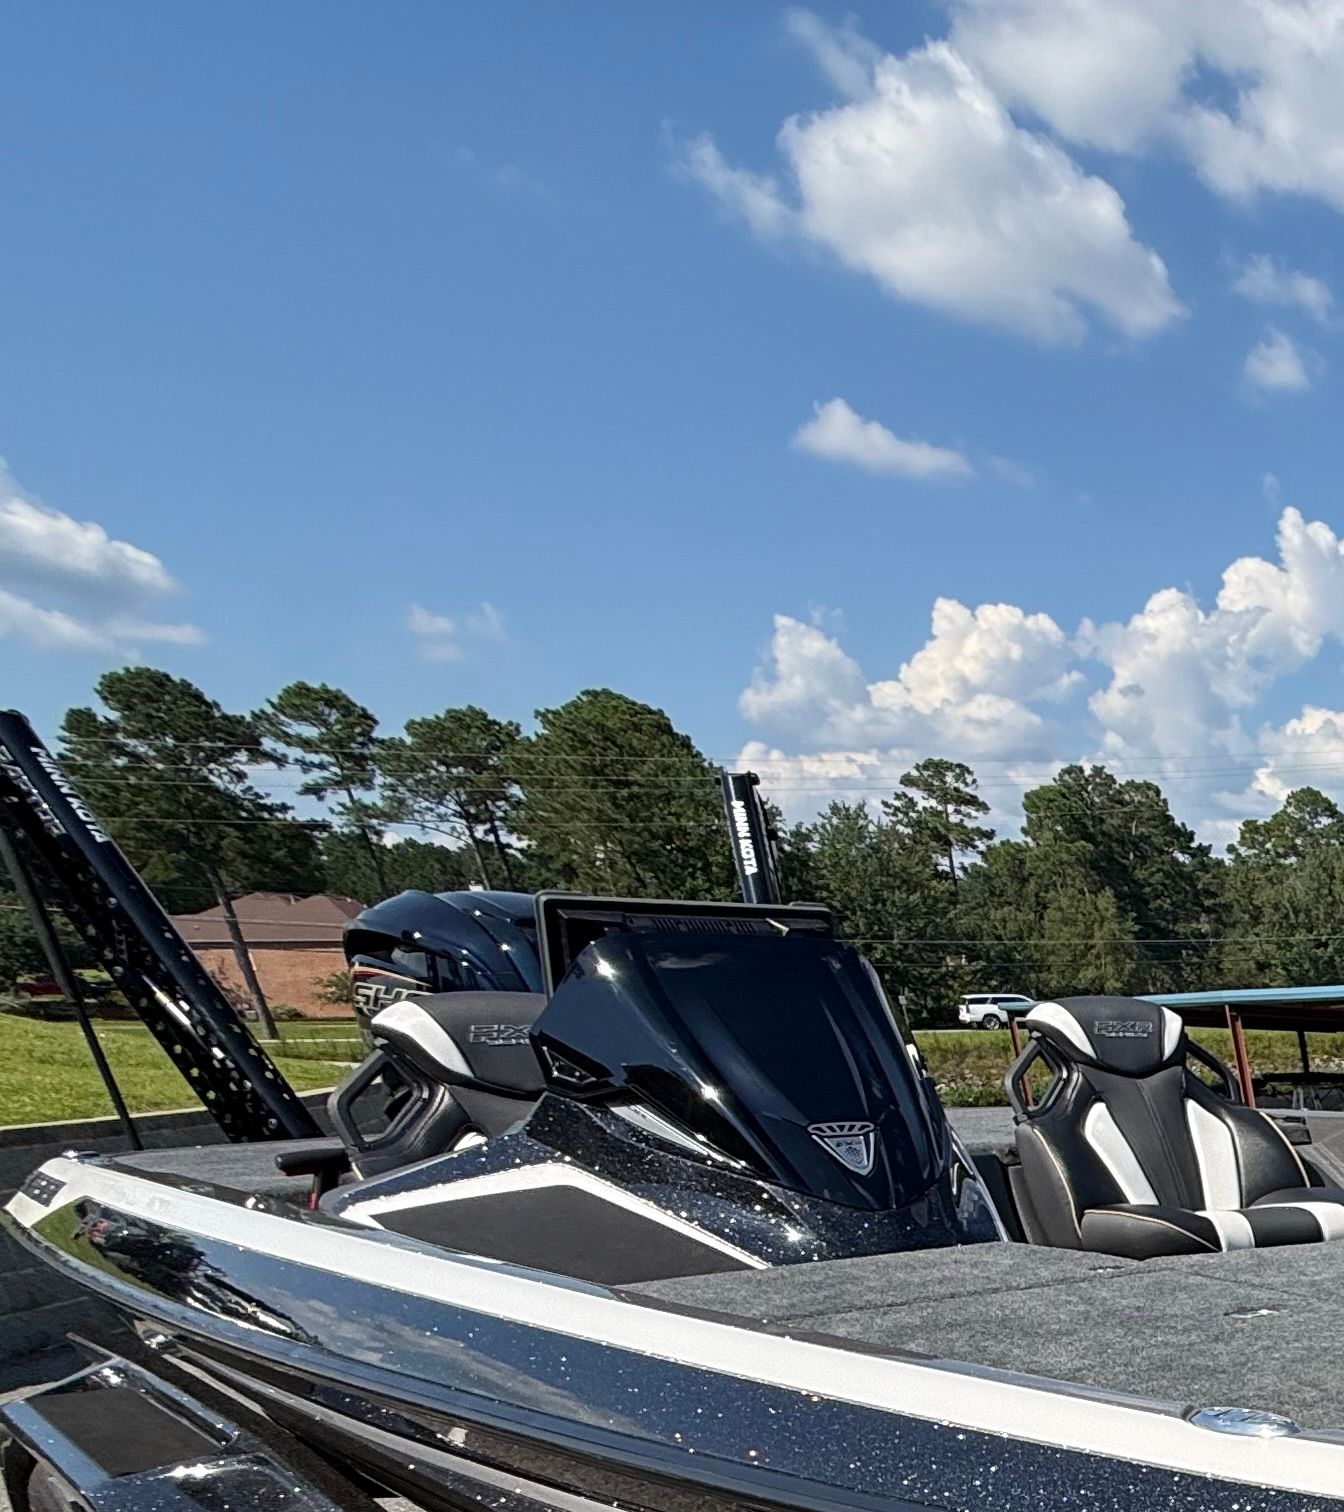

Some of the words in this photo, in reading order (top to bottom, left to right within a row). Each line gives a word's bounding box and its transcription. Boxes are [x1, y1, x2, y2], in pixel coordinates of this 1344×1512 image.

[30, 746, 81, 794] MINN
[66, 795, 113, 844] KOTA
[731, 800, 751, 838] MINN
[739, 839, 758, 876] KOTA
[354, 981, 434, 1015] SH
